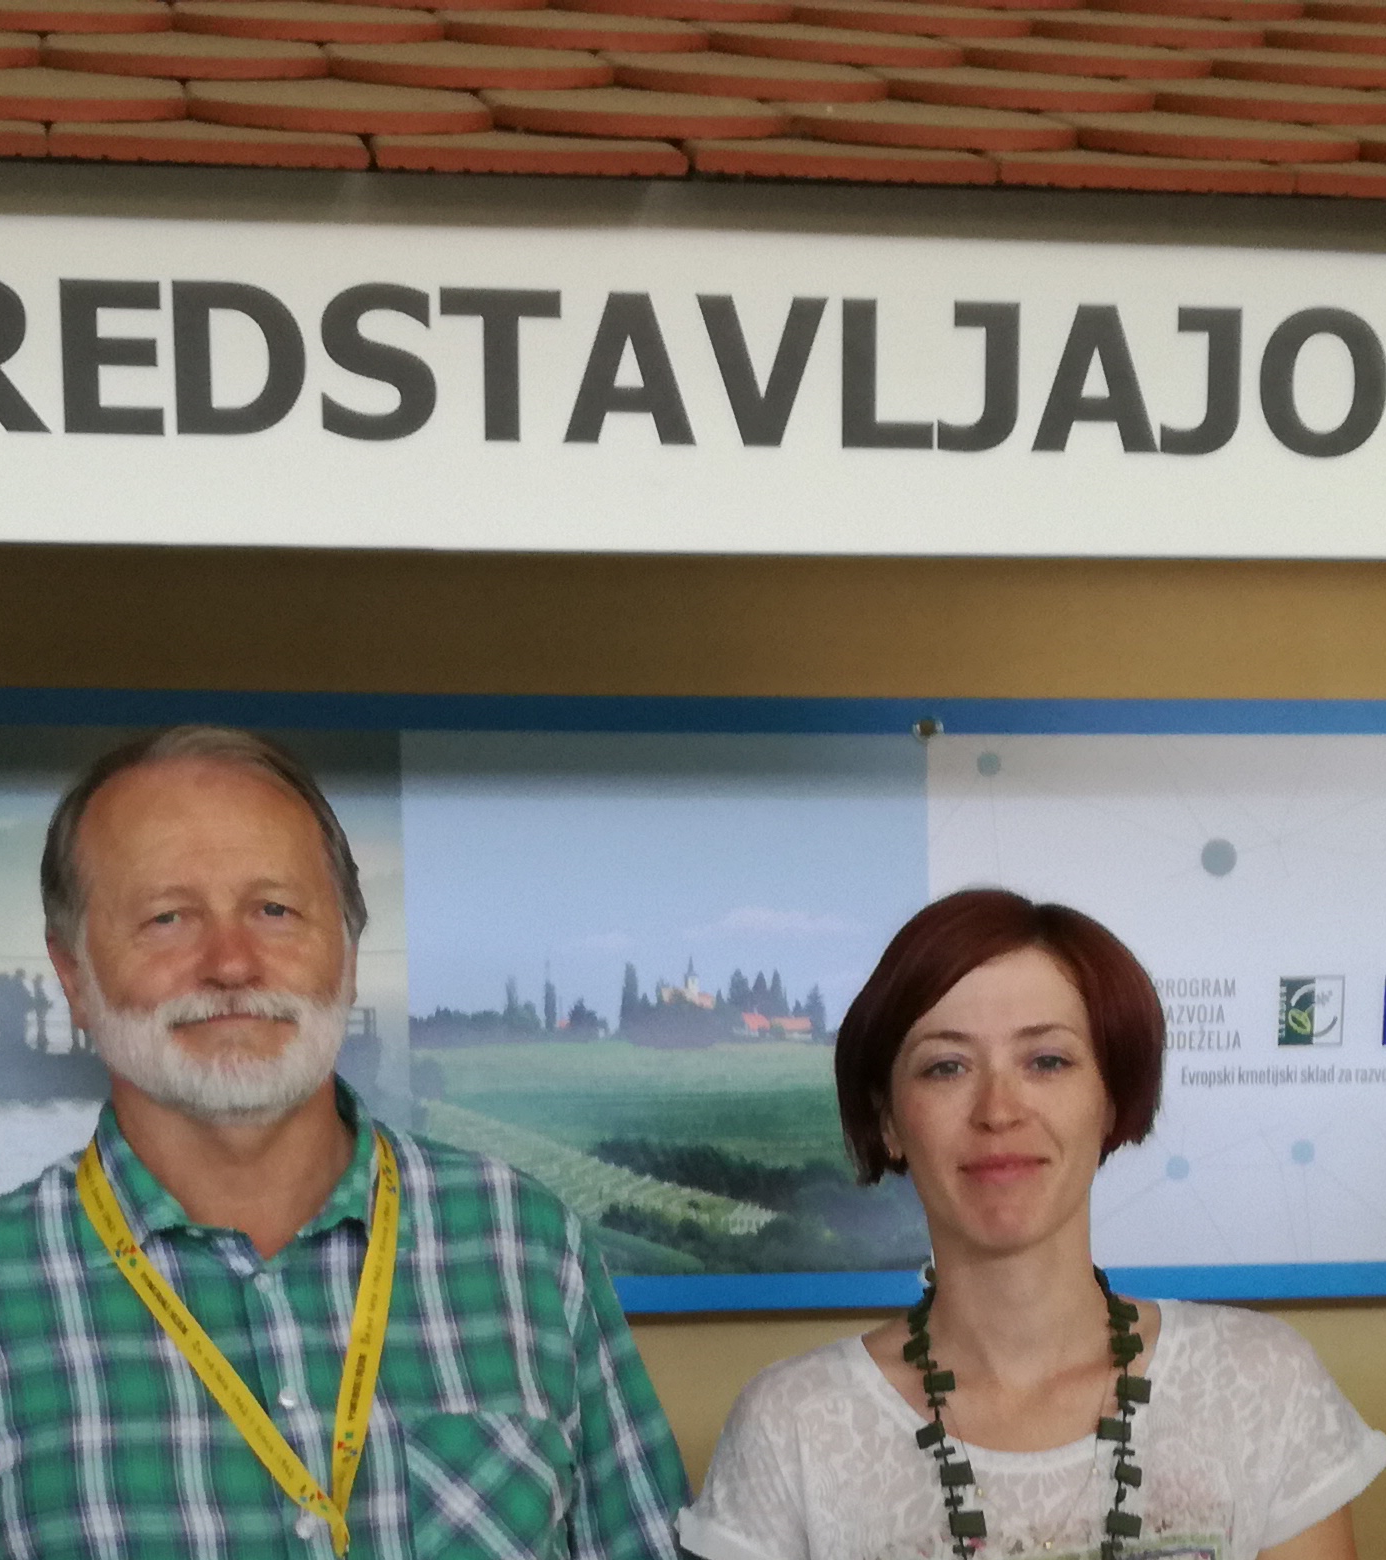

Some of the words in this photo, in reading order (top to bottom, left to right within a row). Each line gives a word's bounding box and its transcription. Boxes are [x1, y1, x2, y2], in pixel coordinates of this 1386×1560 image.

[1164, 1004, 1225, 1024] AZVOJA
[1165, 1026, 1241, 1050] ODEŽELJA
[1180, 1065, 1235, 1088] Evropski
[1238, 1064, 1298, 1087] kmetijski
[1300, 1063, 1335, 1085] sklad
[1338, 1068, 1352, 1083] za
